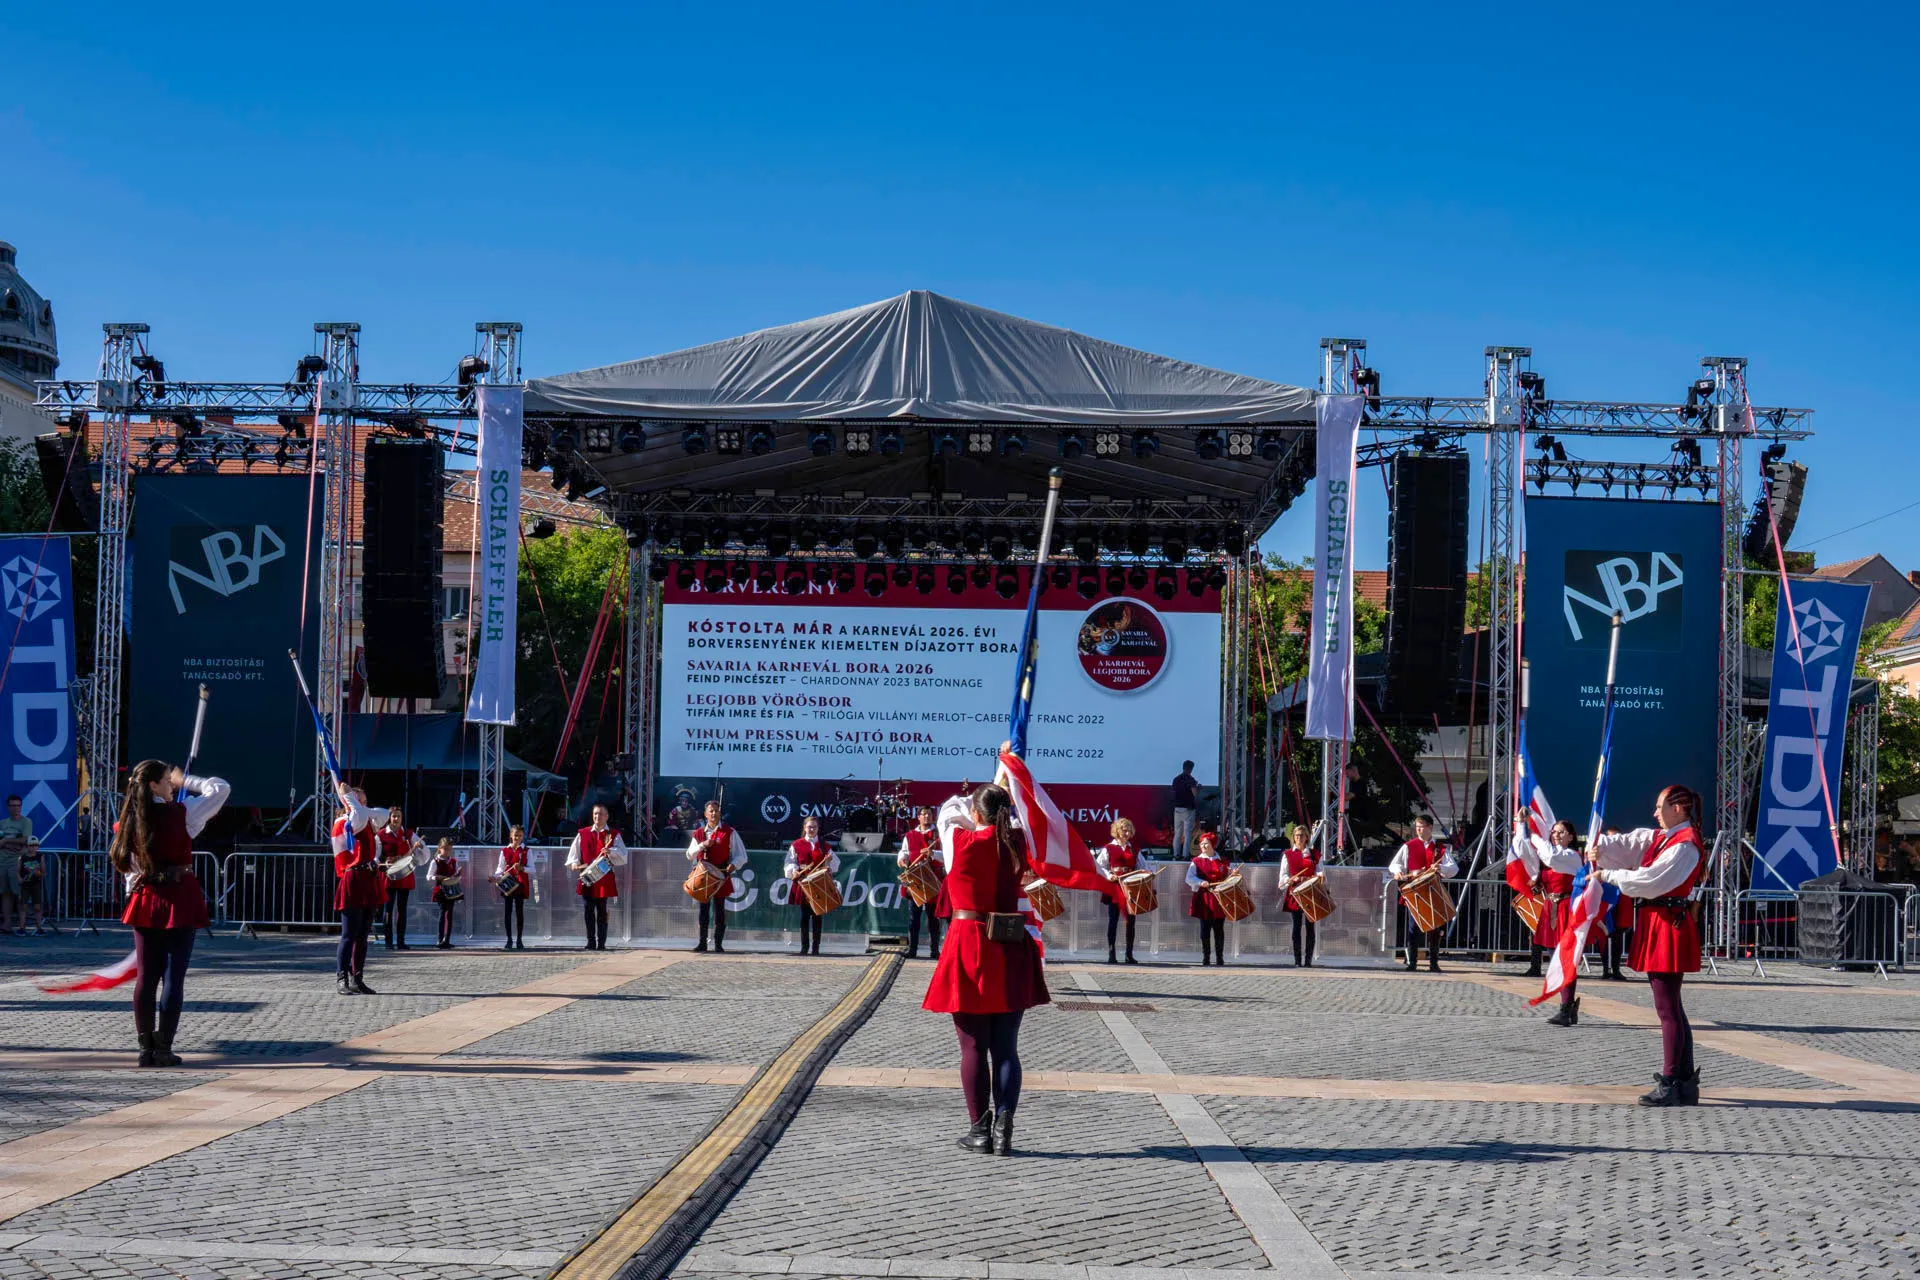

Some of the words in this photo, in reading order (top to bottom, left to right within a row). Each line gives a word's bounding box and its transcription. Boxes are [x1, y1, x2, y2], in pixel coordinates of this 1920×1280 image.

[487, 470, 509, 642] SCHAEFFLER
[169, 524, 286, 615] NBA
[1564, 552, 1683, 641] NBA
[688, 618, 785, 634] KÓSTOLTA
[793, 620, 833, 635] MÁR
[839, 626, 848, 635] A
[853, 624, 925, 637] KARNEVÁL
[930, 627, 969, 637] 2026.
[974, 625, 996, 637] ÉVI
[688, 637, 816, 650] BORVERSENYÉNEK
[821, 640, 899, 652] KIEMELTEN
[905, 641, 975, 652] DÍJAZOTT
[980, 643, 1018, 653] BORA
[183, 658, 203, 666] NBA
[206, 657, 265, 667] BIZTOSÍTÁSI
[687, 660, 752, 672] SAVARIA
[757, 660, 840, 673] KARNEVÁL
[846, 662, 890, 674] BORA
[895, 663, 933, 674] 2026
[182, 670, 242, 680] TANÁCSADÓ
[245, 672, 265, 681] KFT.
[687, 674, 720, 683] FEIND
[724, 673, 786, 684] PINCÉSZET
[801, 676, 880, 686] CHARDONNAY
[884, 677, 910, 687] 2023
[914, 678, 983, 688] BATONNAGE
[1580, 686, 1601, 694] NBA
[687, 694, 757, 707] LEGJOBB
[762, 693, 852, 707] VÖRÖSBOR
[1579, 698, 1641, 709] TANÁSADÓ
[1644, 701, 1665, 709] KFT.
[686, 708, 725, 718] TIFFÁN
[729, 709, 756, 718] IMRE
[761, 708, 773, 718] ÉS
[777, 710, 795, 719] FIA
[813, 709, 864, 720] TRILÓGIA
[868, 710, 918, 721] VILLÁNYI
[1037, 714, 1074, 724] FRANC
[1078, 715, 1105, 724] 2022
[9, 618, 69, 831] TDK
[686, 728, 740, 740] VINUM
[745, 729, 819, 741] PRESSUM
[835, 729, 883, 744] SAJTÓ
[889, 731, 933, 743] BORA
[686, 742, 724, 752] TIFFÁN
[728, 743, 756, 752] IMRE
[760, 742, 773, 752] ÉS
[776, 743, 794, 753] FIA
[812, 743, 864, 754] TRILÓGIA
[868, 744, 917, 756] VILLÁNYI
[1037, 748, 1073, 758] FRANC
[1077, 749, 1104, 758] 2022
[1764, 665, 1838, 879] TDK
[766, 805, 786, 813] XXV
